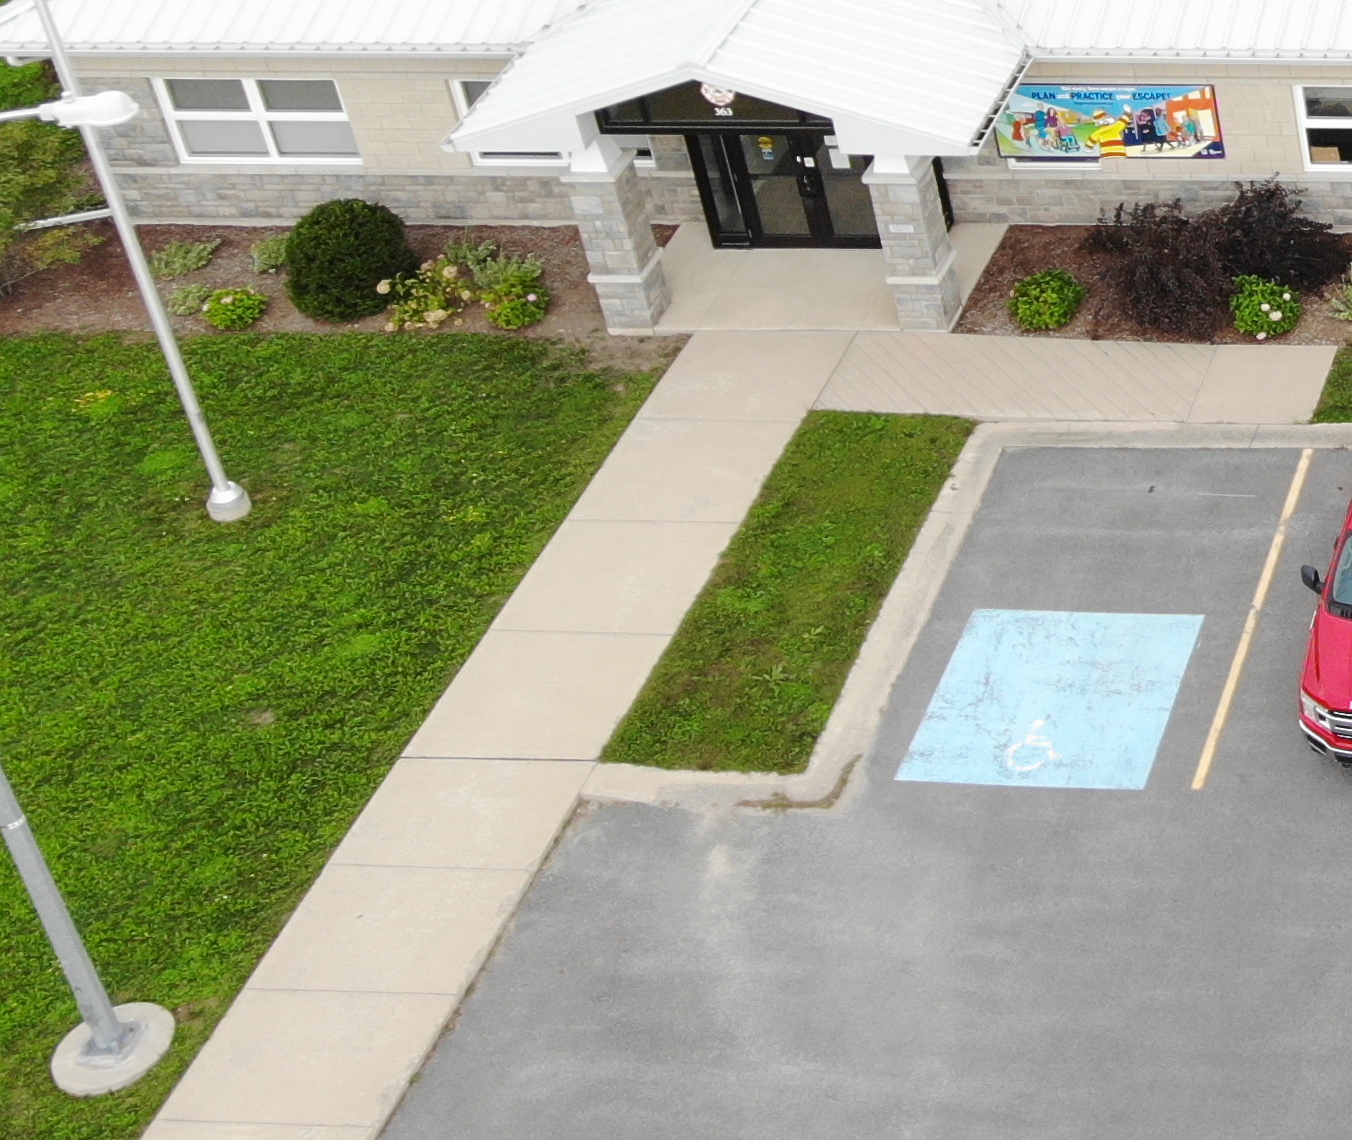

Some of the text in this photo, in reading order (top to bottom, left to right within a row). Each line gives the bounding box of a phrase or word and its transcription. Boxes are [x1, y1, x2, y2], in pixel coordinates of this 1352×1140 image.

[1031, 91, 1056, 100] PLAN
[1070, 91, 1113, 100] PRACTICE
[714, 107, 733, 116] 363
